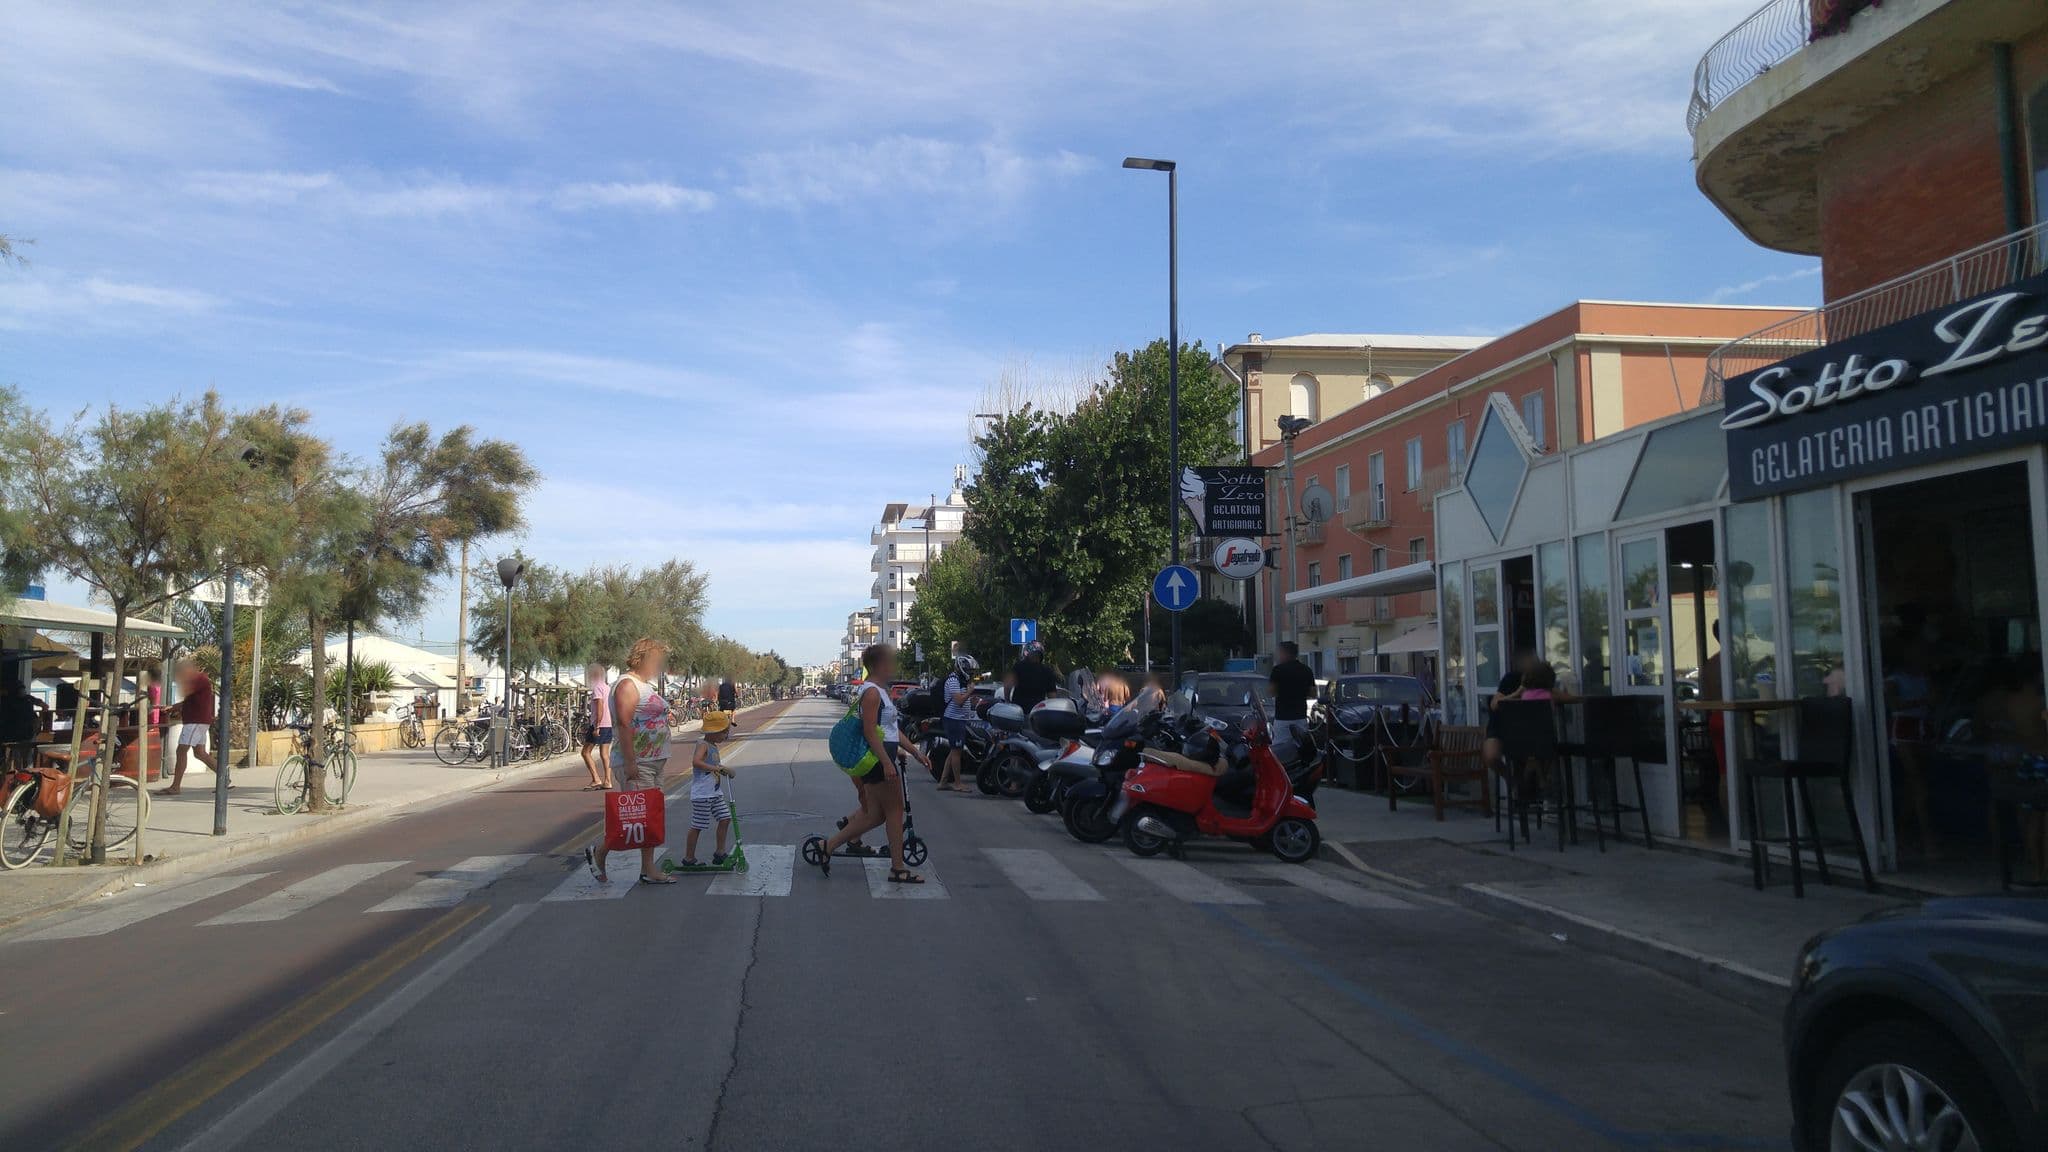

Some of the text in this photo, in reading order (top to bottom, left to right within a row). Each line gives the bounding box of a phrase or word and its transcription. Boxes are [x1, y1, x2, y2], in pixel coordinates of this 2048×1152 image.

[1720, 354, 1909, 430] Sotto
[1752, 416, 1893, 486] GELATERIA
[1206, 469, 1264, 485] Sotto
[1218, 485, 1264, 500] Zero
[1213, 505, 1261, 515] GELATERIA
[1212, 519, 1263, 530] ARTIGIANALE
[618, 793, 646, 806] OVS
[622, 822, 645, 845] 70
